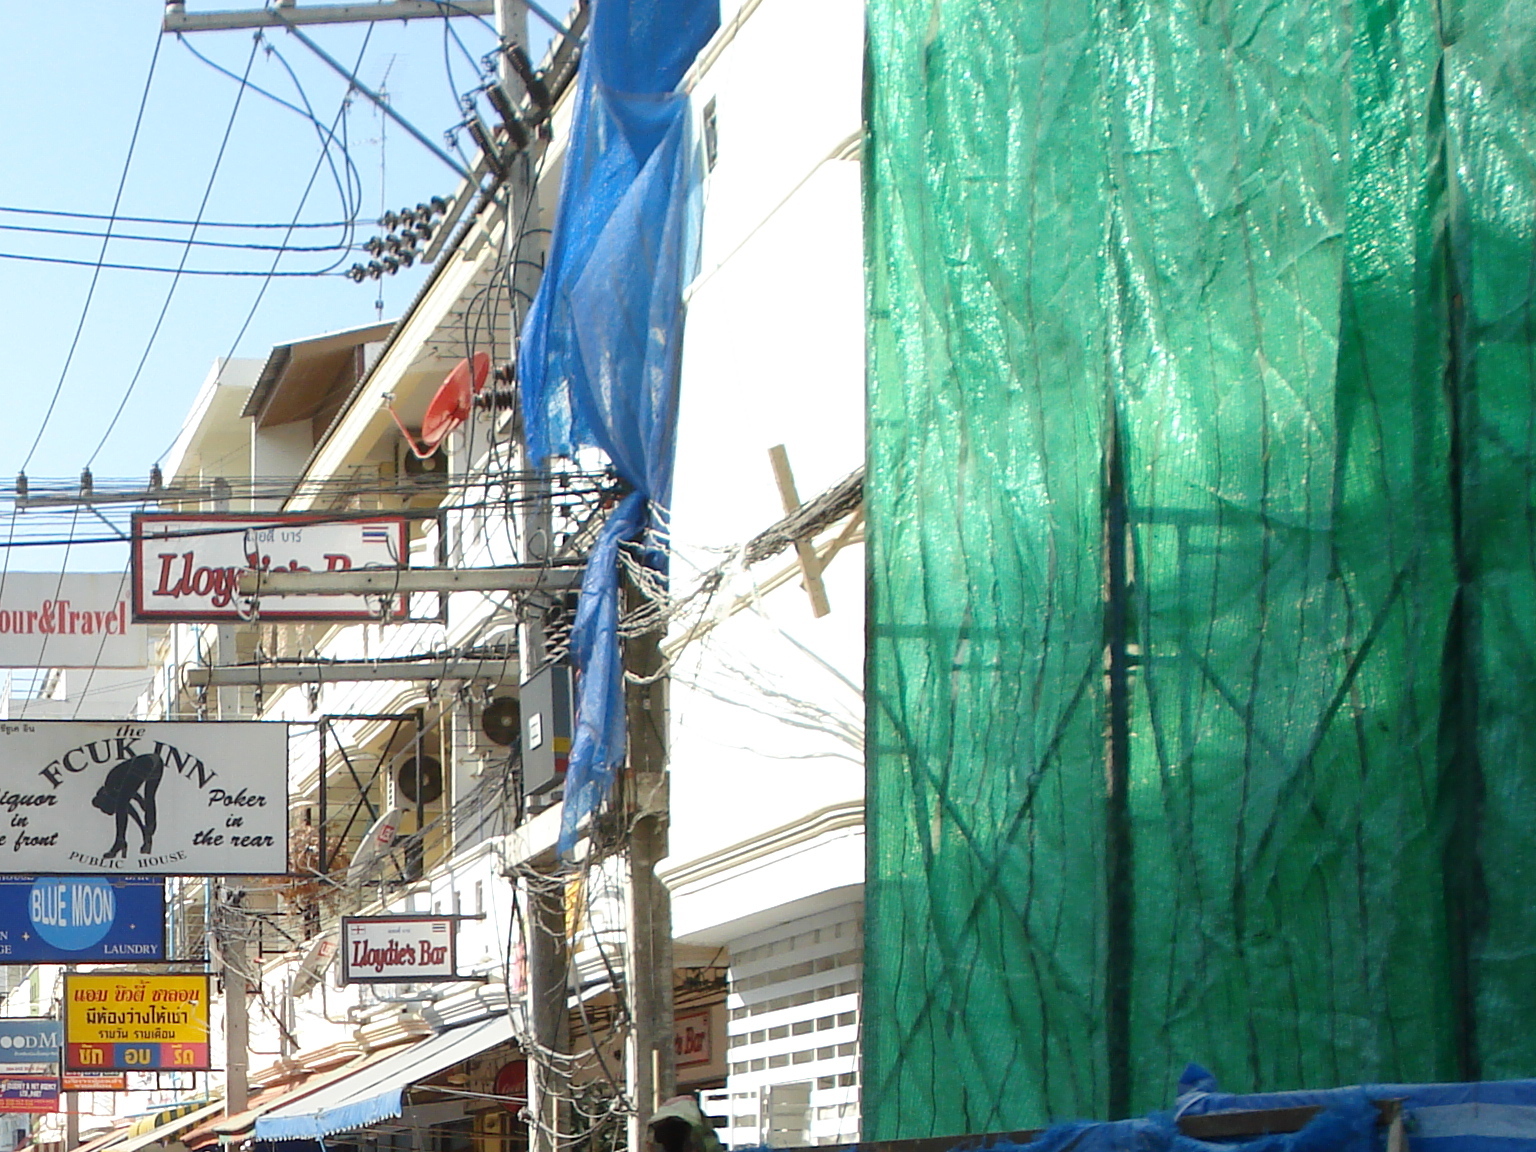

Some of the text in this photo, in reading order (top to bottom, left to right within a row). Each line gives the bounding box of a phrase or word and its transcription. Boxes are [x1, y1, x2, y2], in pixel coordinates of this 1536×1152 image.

[116, 725, 145, 737] the
[38, 738, 218, 789] FCUK INN
[208, 787, 267, 807] Poker
[11, 814, 28, 827] in
[225, 814, 243, 828] in
[14, 831, 59, 852] front
[192, 828, 275, 847] the rear
[69, 850, 187, 869] PUBLIC HOUSE
[32, 884, 113, 926] BLUE MOON
[104, 945, 158, 954] LAUNDRY
[351, 939, 448, 973] Lloydie's Bar
[86, 1005, 188, 1024] มีห้องว่างให้เช่า
[98, 1027, 175, 1039] รายวัน รายเดือน
[125, 1048, 151, 1065] อบ
